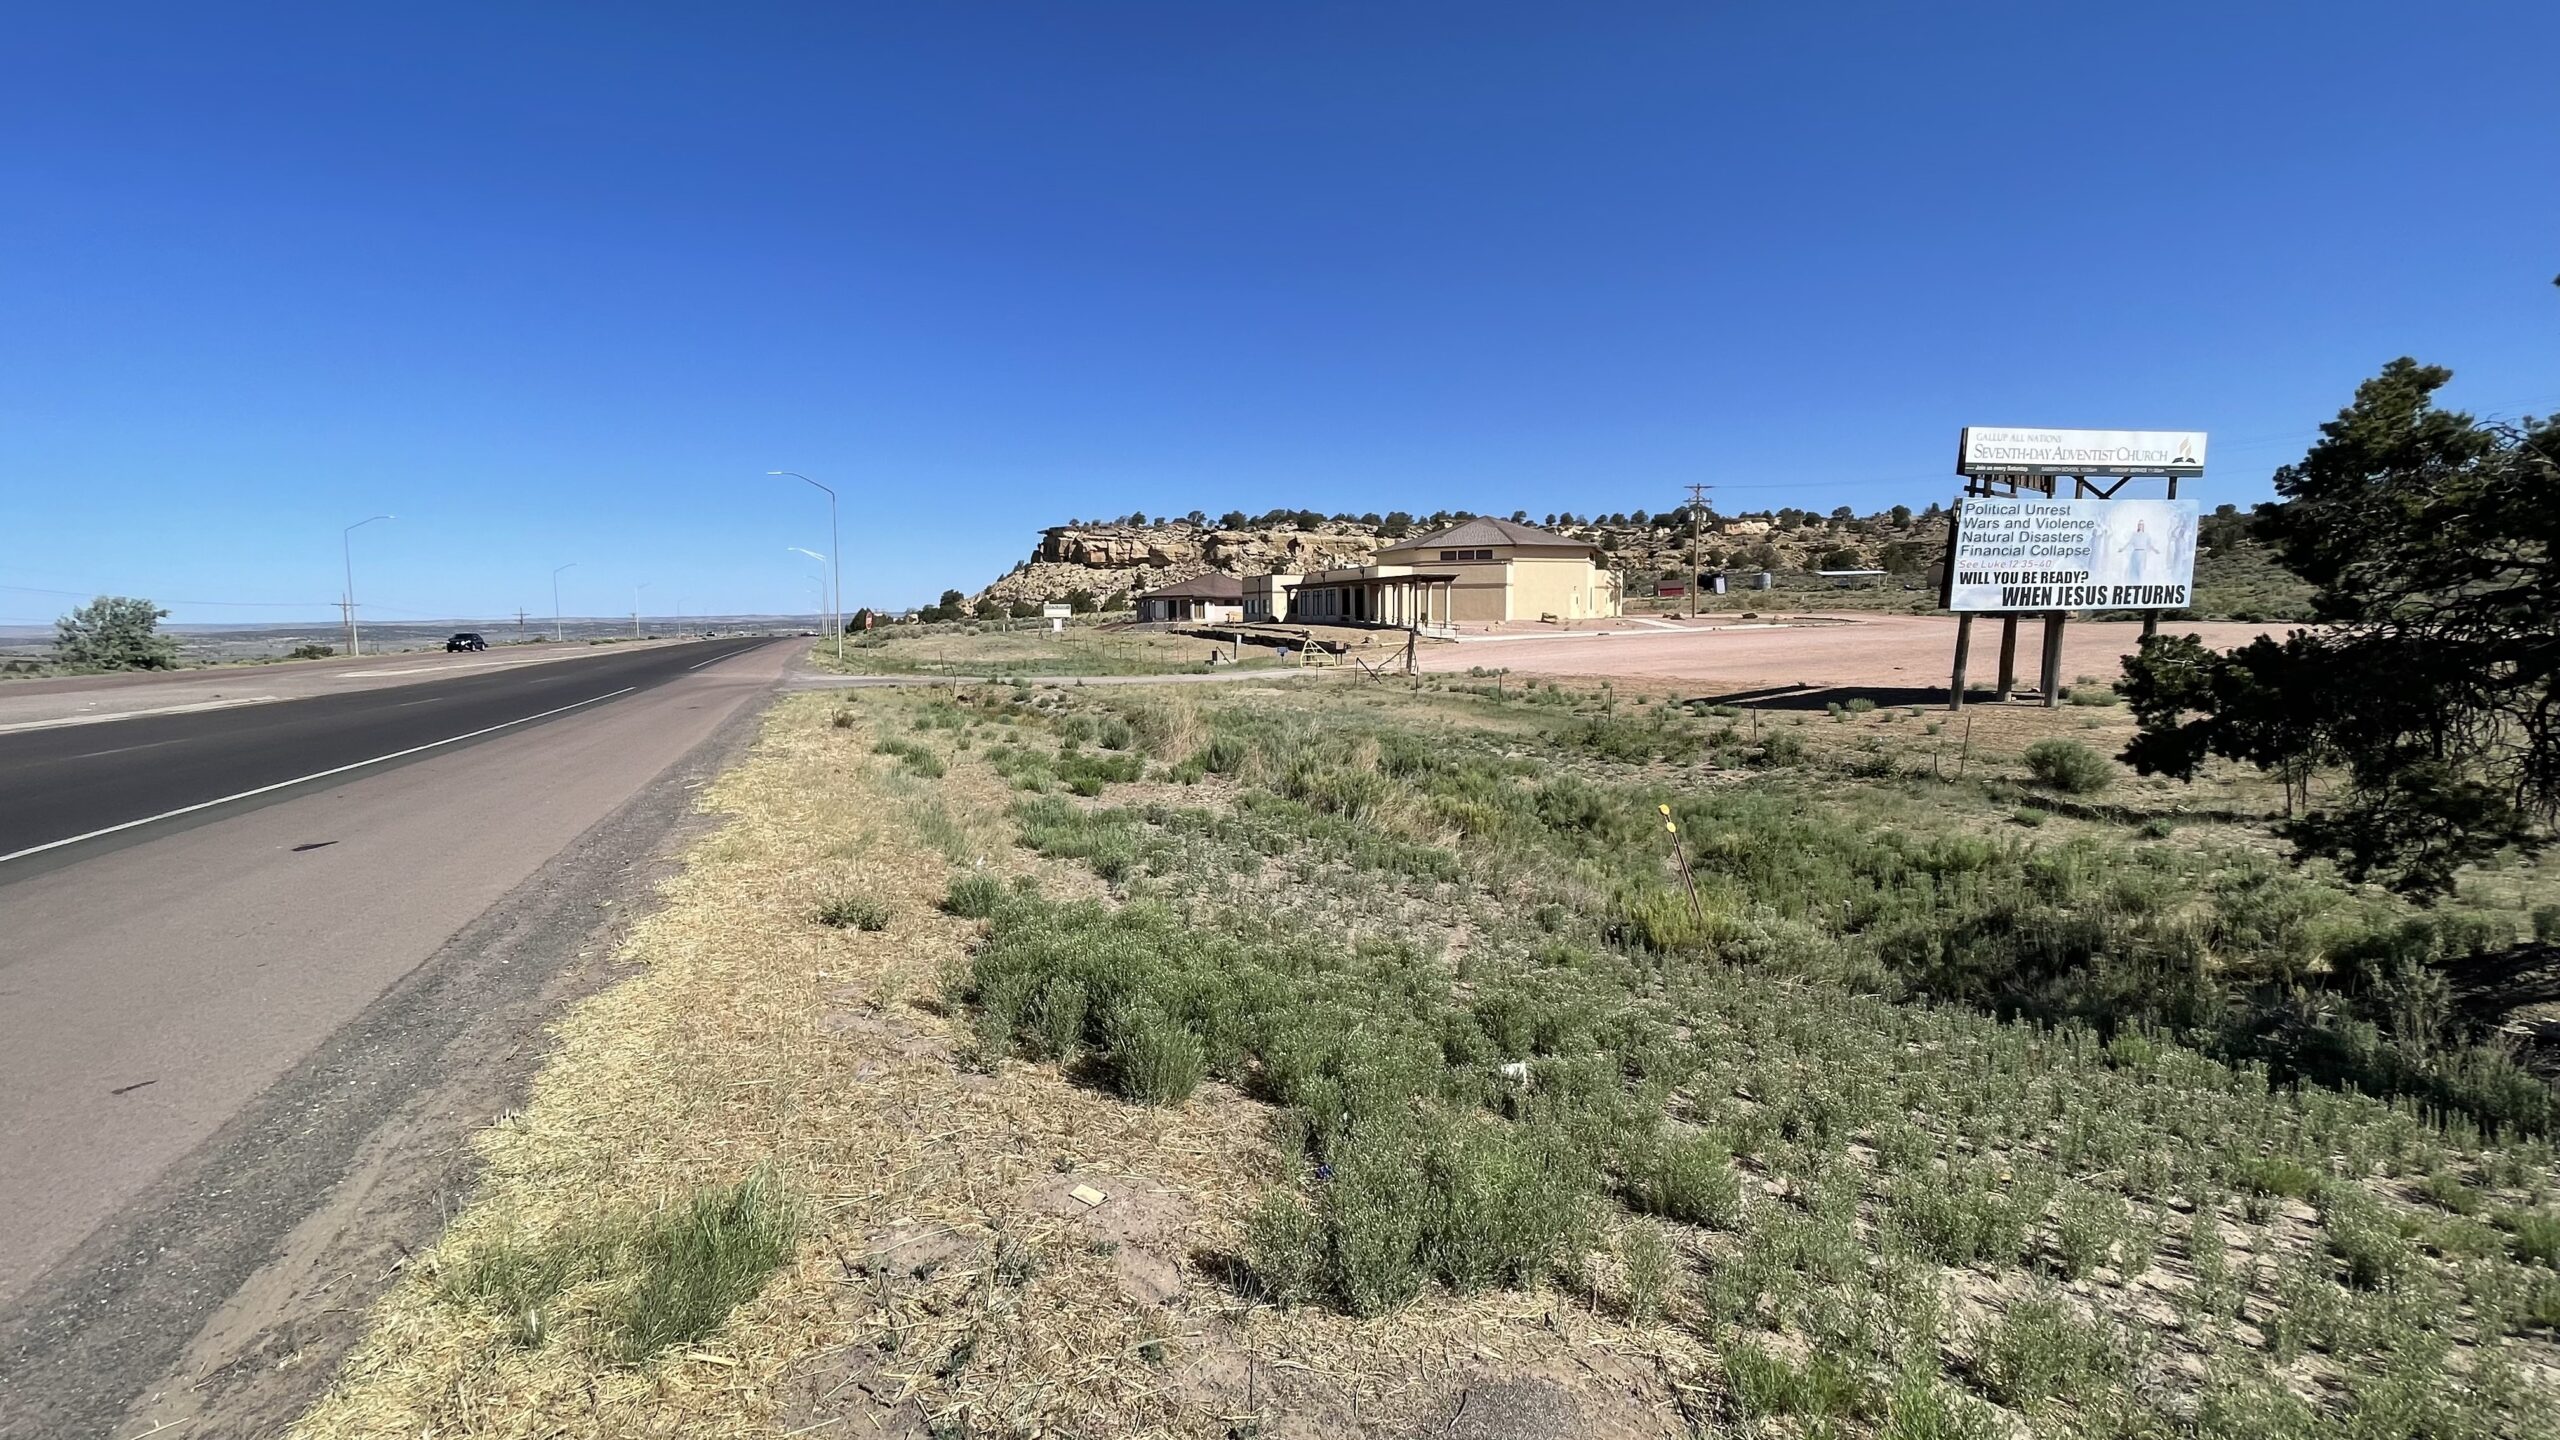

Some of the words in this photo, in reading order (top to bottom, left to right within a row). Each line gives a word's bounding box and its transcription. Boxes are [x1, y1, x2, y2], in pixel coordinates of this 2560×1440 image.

[1976, 433, 2009, 442] GALLUP
[2011, 433, 2026, 443] ALL
[2027, 434, 2063, 444] NATIONS
[2116, 446, 2168, 462] CHURCH
[1965, 503, 2020, 515] Political
[2025, 504, 2071, 516] Unrest
[1963, 517, 2000, 529] Wars
[2004, 518, 2031, 529] and
[2036, 518, 2095, 529] Violence
[1962, 531, 2014, 543] Natural
[2019, 531, 2084, 543] Disasters
[1960, 545, 2025, 556] Financial
[2030, 545, 2091, 558] Collapse
[1959, 559, 1979, 569] See
[1981, 559, 2007, 569] Luke
[1959, 571, 1990, 585] WILL
[1993, 571, 2019, 584] YOU
[2021, 571, 2038, 584] BE
[2040, 570, 2089, 584] READY?
[2002, 586, 2053, 607] WHEN
[2056, 585, 2108, 607] JESUS
[2112, 585, 2186, 605] RETURNS
